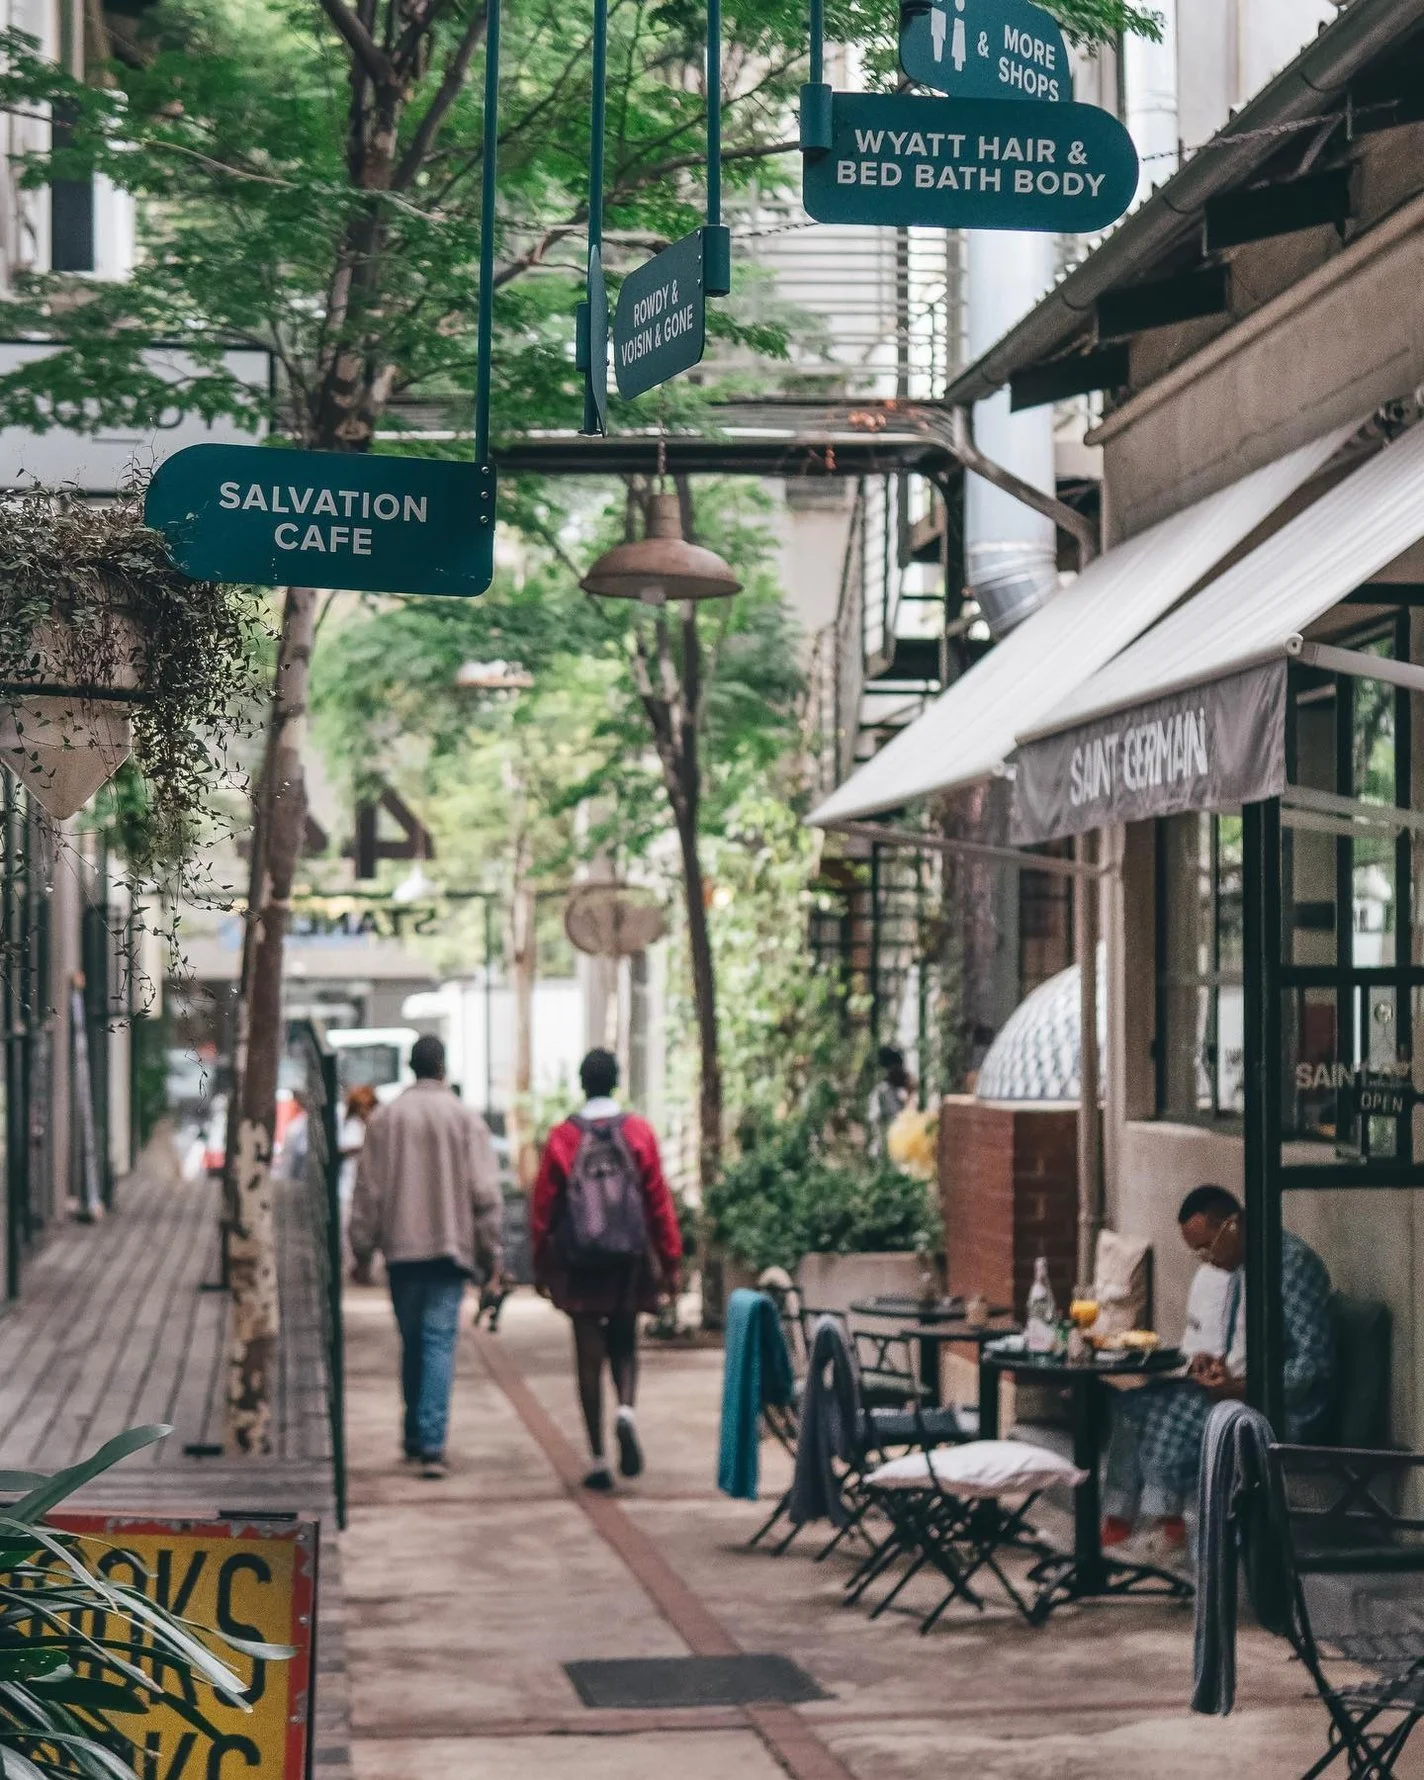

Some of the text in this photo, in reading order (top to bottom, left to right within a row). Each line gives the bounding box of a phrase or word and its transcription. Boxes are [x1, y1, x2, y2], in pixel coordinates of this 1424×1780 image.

[977, 24, 1056, 71] & MORE
[998, 56, 1060, 102] SHOPS
[855, 129, 1088, 165] WYATT HAIR &
[837, 160, 1106, 197] BED BATH BODY
[633, 279, 679, 328] ROWDY &
[621, 303, 694, 367] VOISIN & GONE
[218, 481, 428, 523] SALVATION
[274, 522, 373, 556] CAFE
[1070, 706, 1209, 808] SAINT GERMAIN
[1360, 1091, 1404, 1113] OPEN
